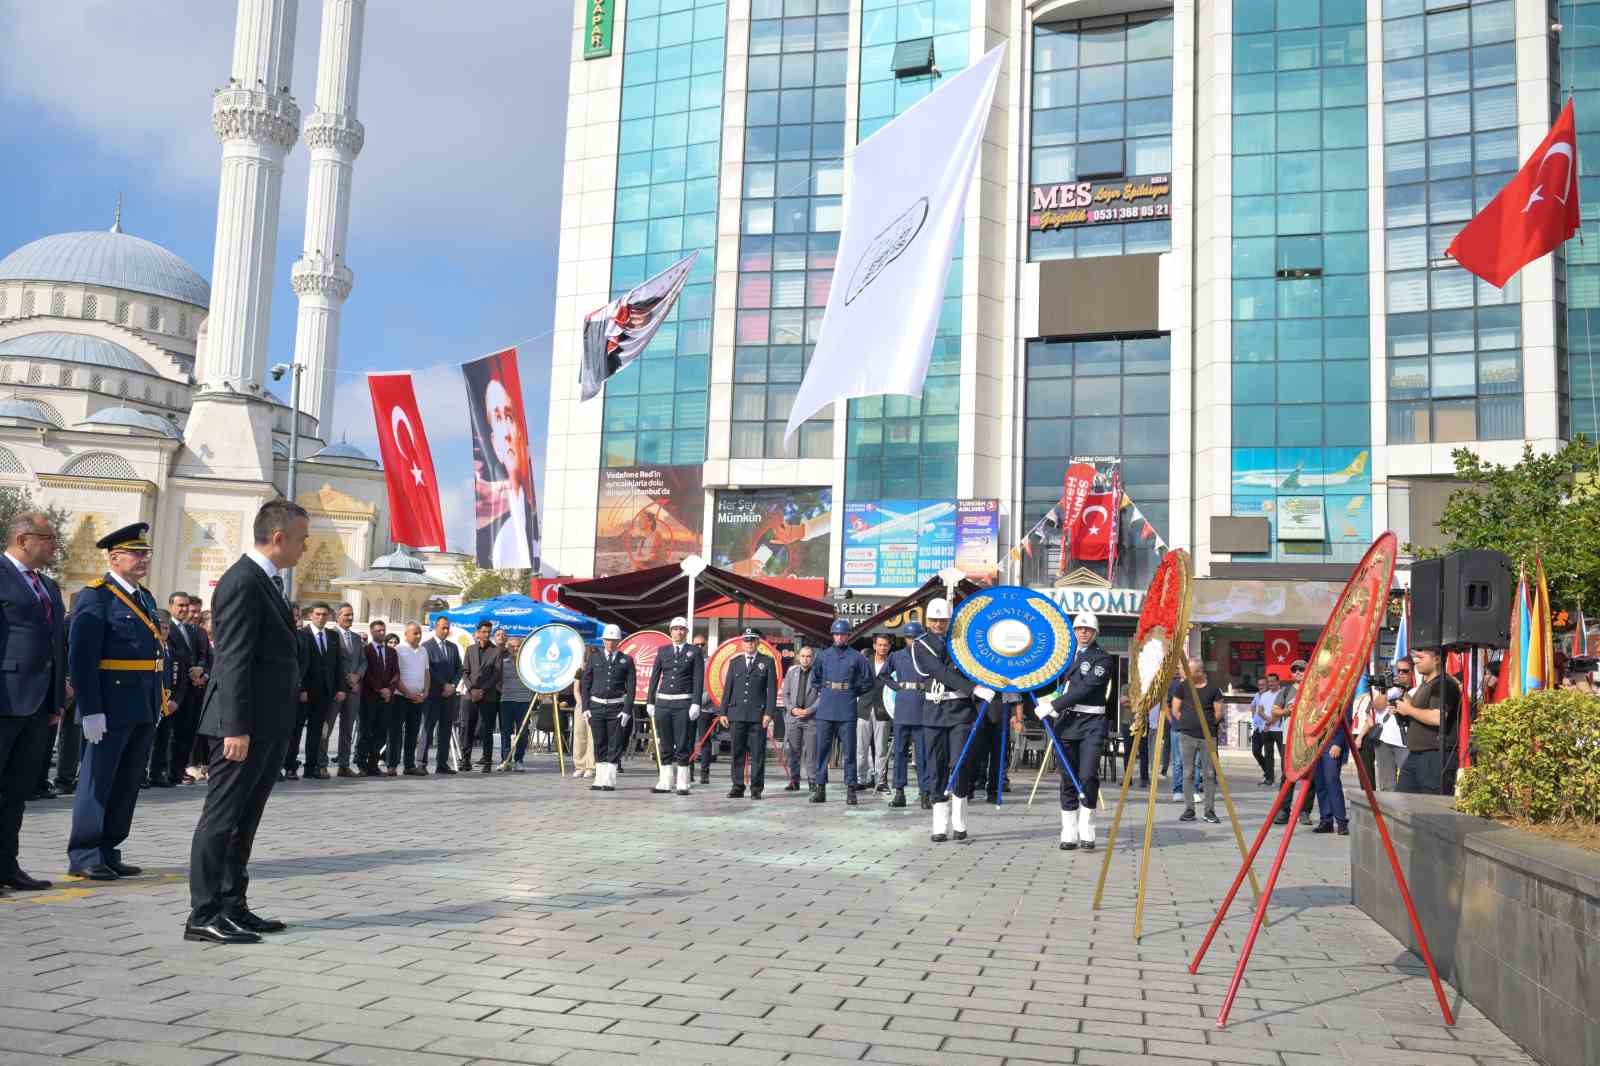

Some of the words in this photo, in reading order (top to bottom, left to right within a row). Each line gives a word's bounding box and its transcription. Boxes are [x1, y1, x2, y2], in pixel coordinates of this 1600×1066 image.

[1032, 183, 1092, 210] MES
[1094, 208, 1117, 220] 0531
[718, 512, 762, 523] Mümkün
[1050, 591, 1145, 614] AROMI
